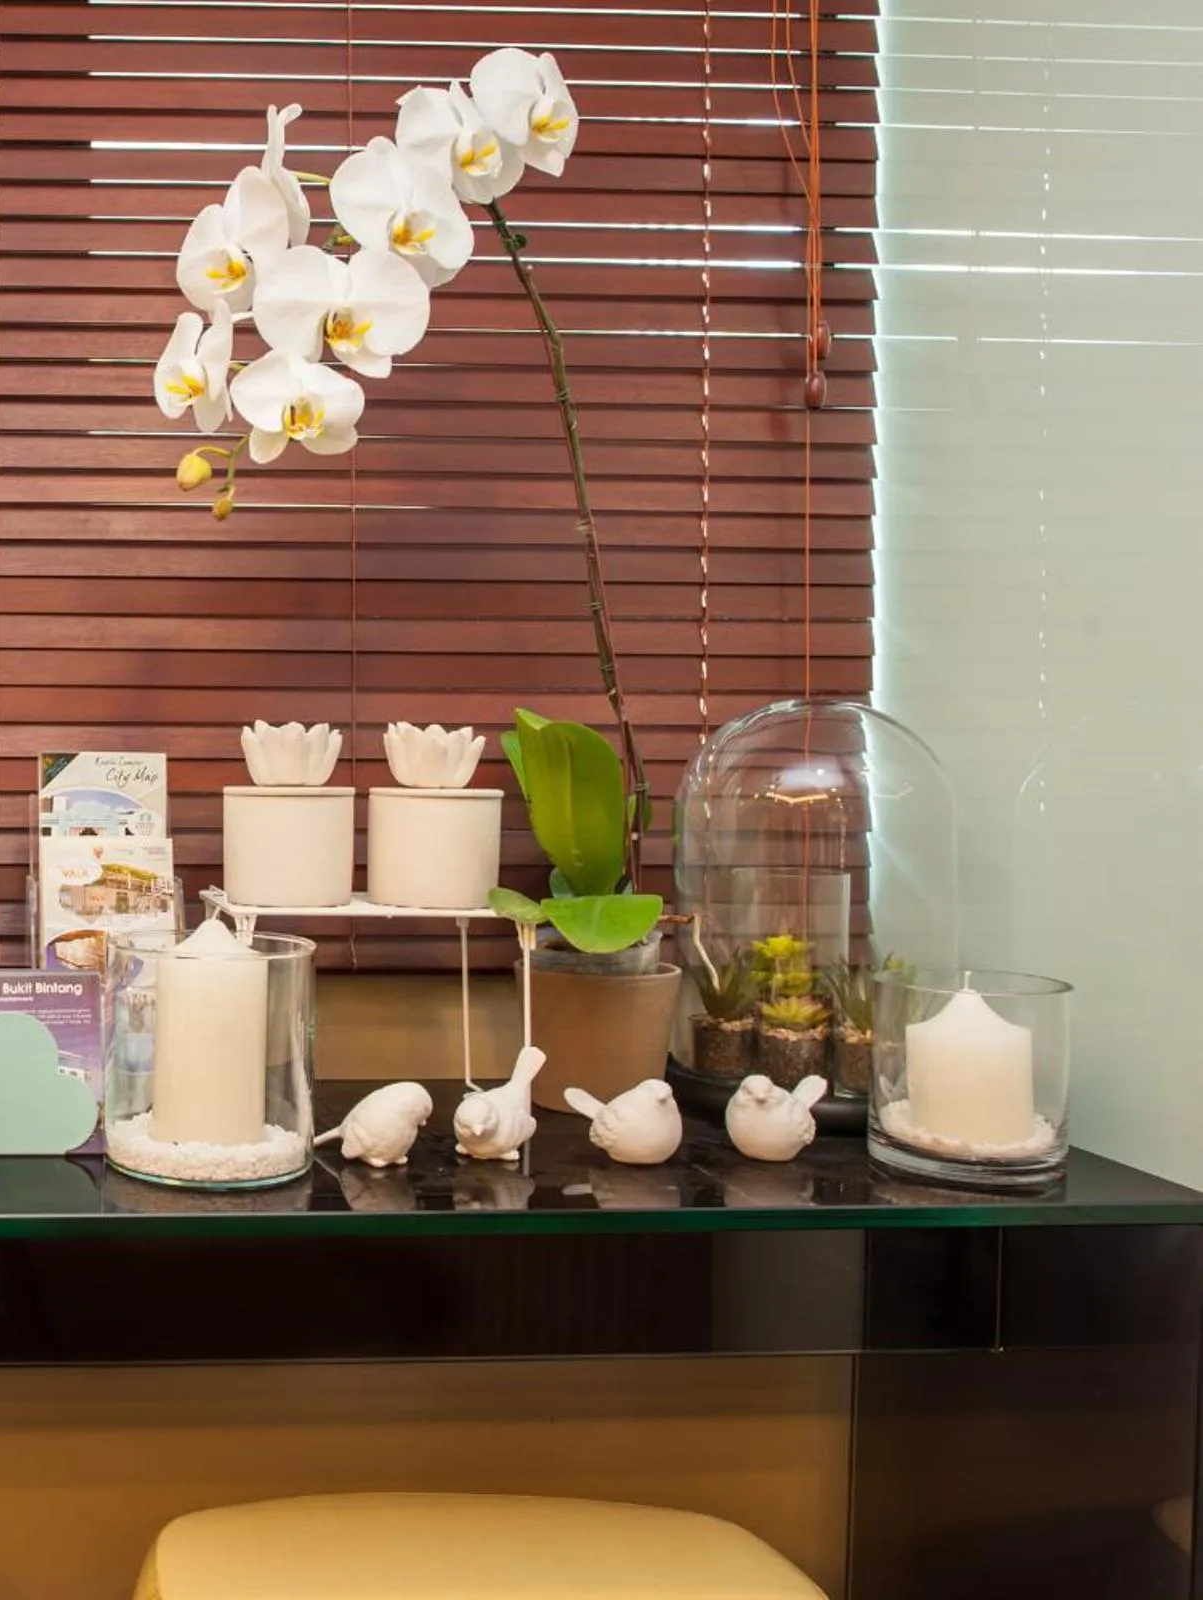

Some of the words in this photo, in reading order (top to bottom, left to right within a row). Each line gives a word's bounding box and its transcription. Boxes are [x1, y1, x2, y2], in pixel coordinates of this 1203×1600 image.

[106, 767, 132, 788] City
[133, 766, 159, 784] Map
[2, 982, 32, 994] Bukit
[35, 982, 83, 996] Bintang
